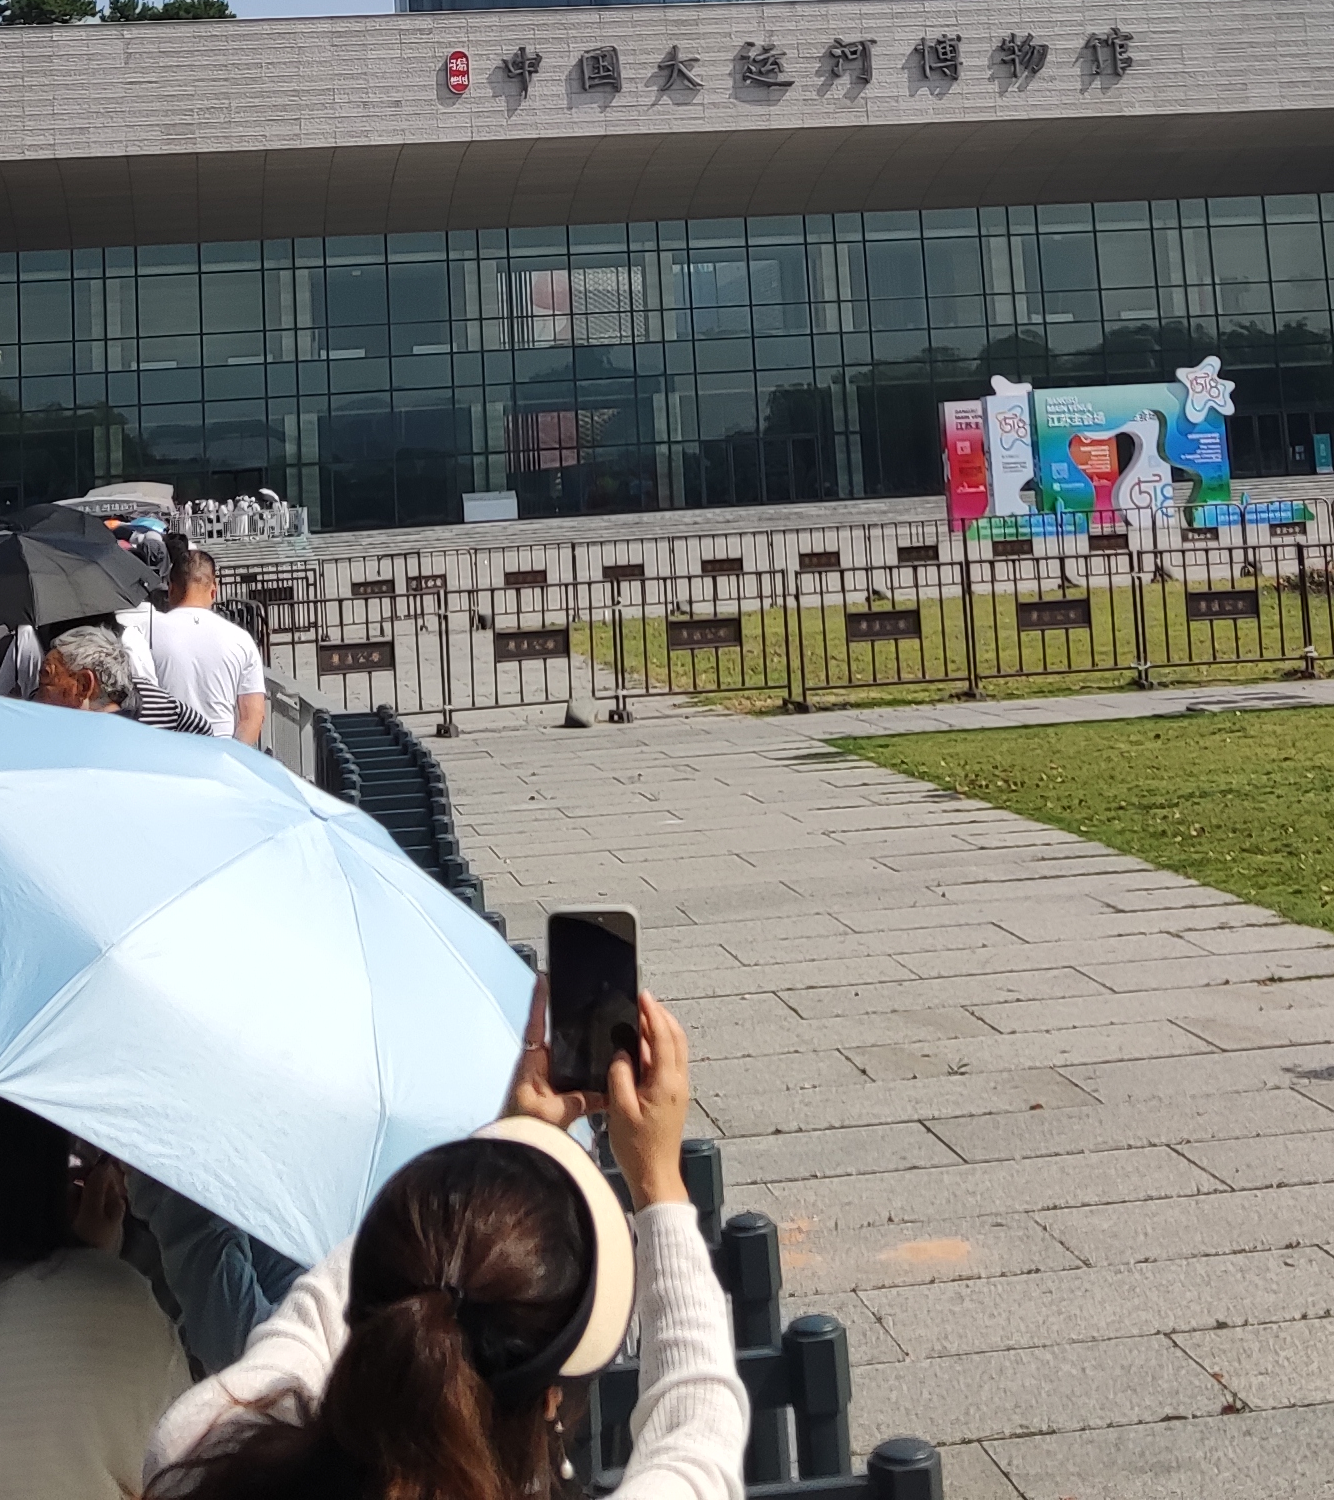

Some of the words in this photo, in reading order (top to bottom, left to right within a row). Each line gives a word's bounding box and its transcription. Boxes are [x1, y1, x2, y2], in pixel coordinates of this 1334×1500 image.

[501, 27, 1135, 99] 中国大运河博物馆
